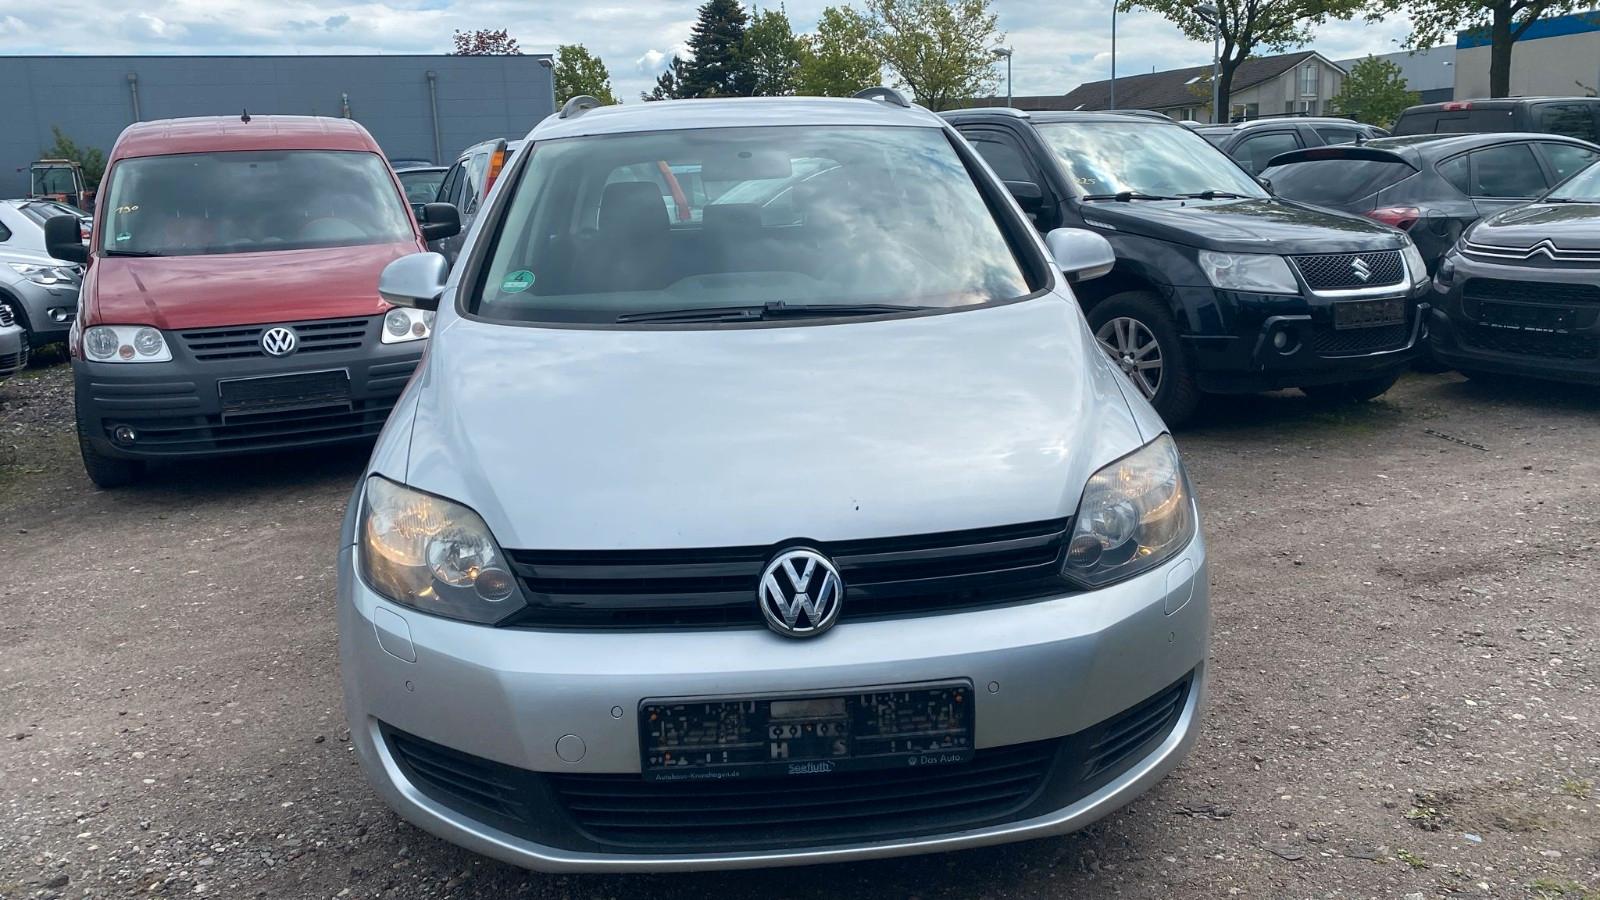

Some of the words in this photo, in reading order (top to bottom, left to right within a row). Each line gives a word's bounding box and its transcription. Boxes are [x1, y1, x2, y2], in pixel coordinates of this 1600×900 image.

[514, 271, 526, 283] 4
[759, 546, 842, 637] VW
[920, 754, 938, 764] Das
